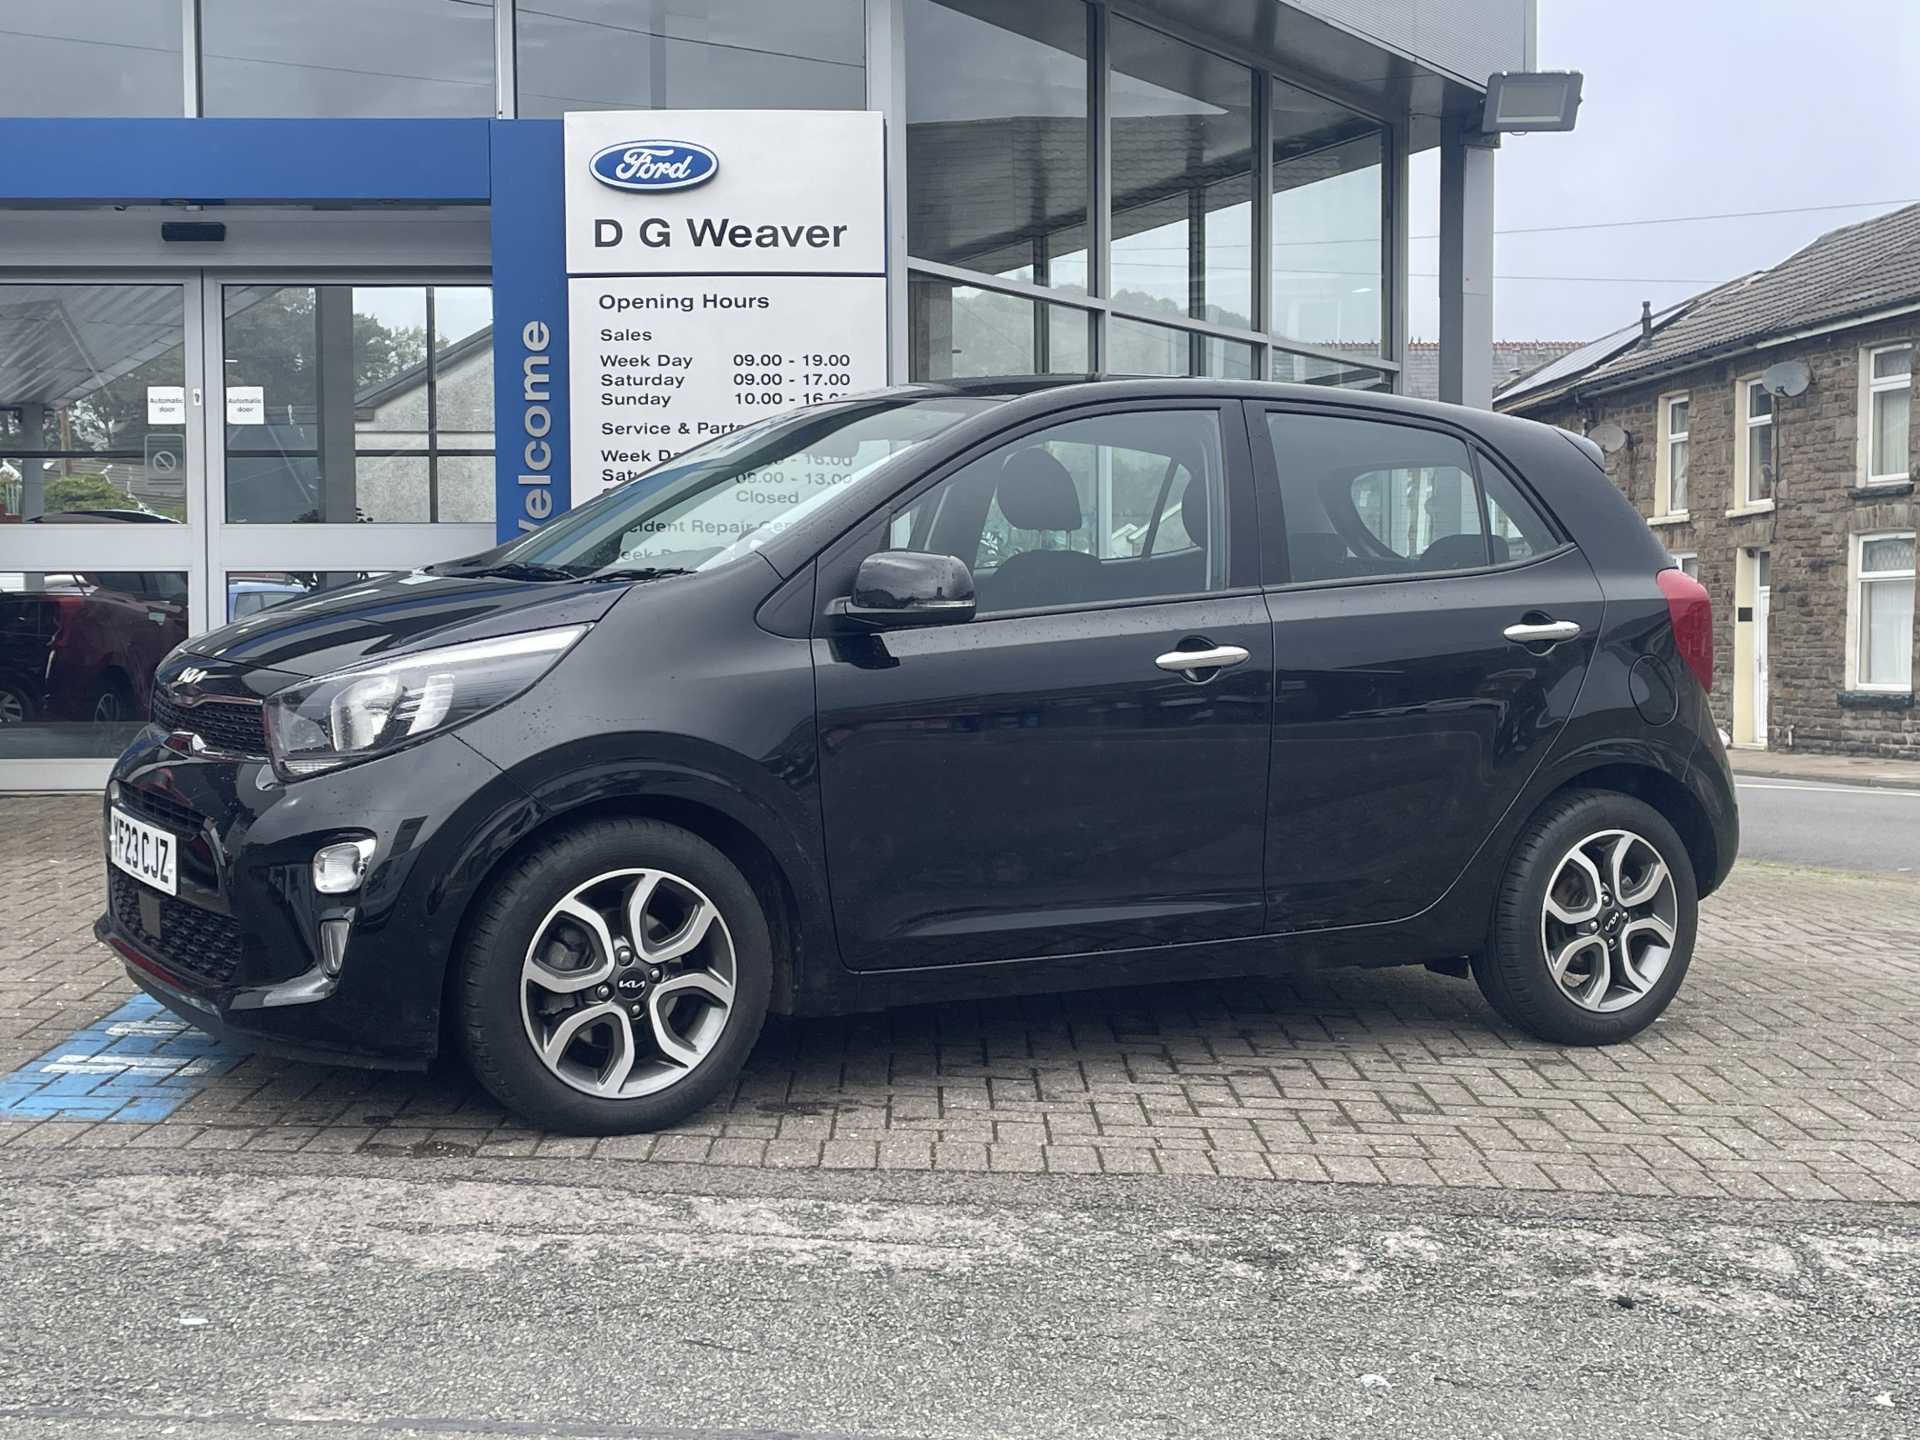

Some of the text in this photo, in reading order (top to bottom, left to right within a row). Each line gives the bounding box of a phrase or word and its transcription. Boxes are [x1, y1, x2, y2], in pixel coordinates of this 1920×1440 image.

[616, 147, 694, 181] Ford
[594, 218, 848, 248] D G Weaver
[599, 294, 770, 312] Opening Hours
[600, 328, 653, 342] Sales
[600, 354, 650, 367] Week
[658, 354, 693, 370] Day
[733, 353, 783, 367] 09.00
[802, 353, 851, 367] 19.00
[601, 373, 686, 390] Saturday
[733, 373, 783, 387] 09.00
[803, 373, 851, 387] 17.00
[601, 393, 672, 409] Sunday
[734, 392, 783, 406] 10.00
[517, 320, 553, 534] elcome
[601, 422, 671, 436] Service
[678, 422, 690, 435] &
[601, 450, 650, 463] Week
[736, 490, 799, 505] Closed
[691, 520, 746, 536] Repair
[141, 831, 169, 884] CJZ
